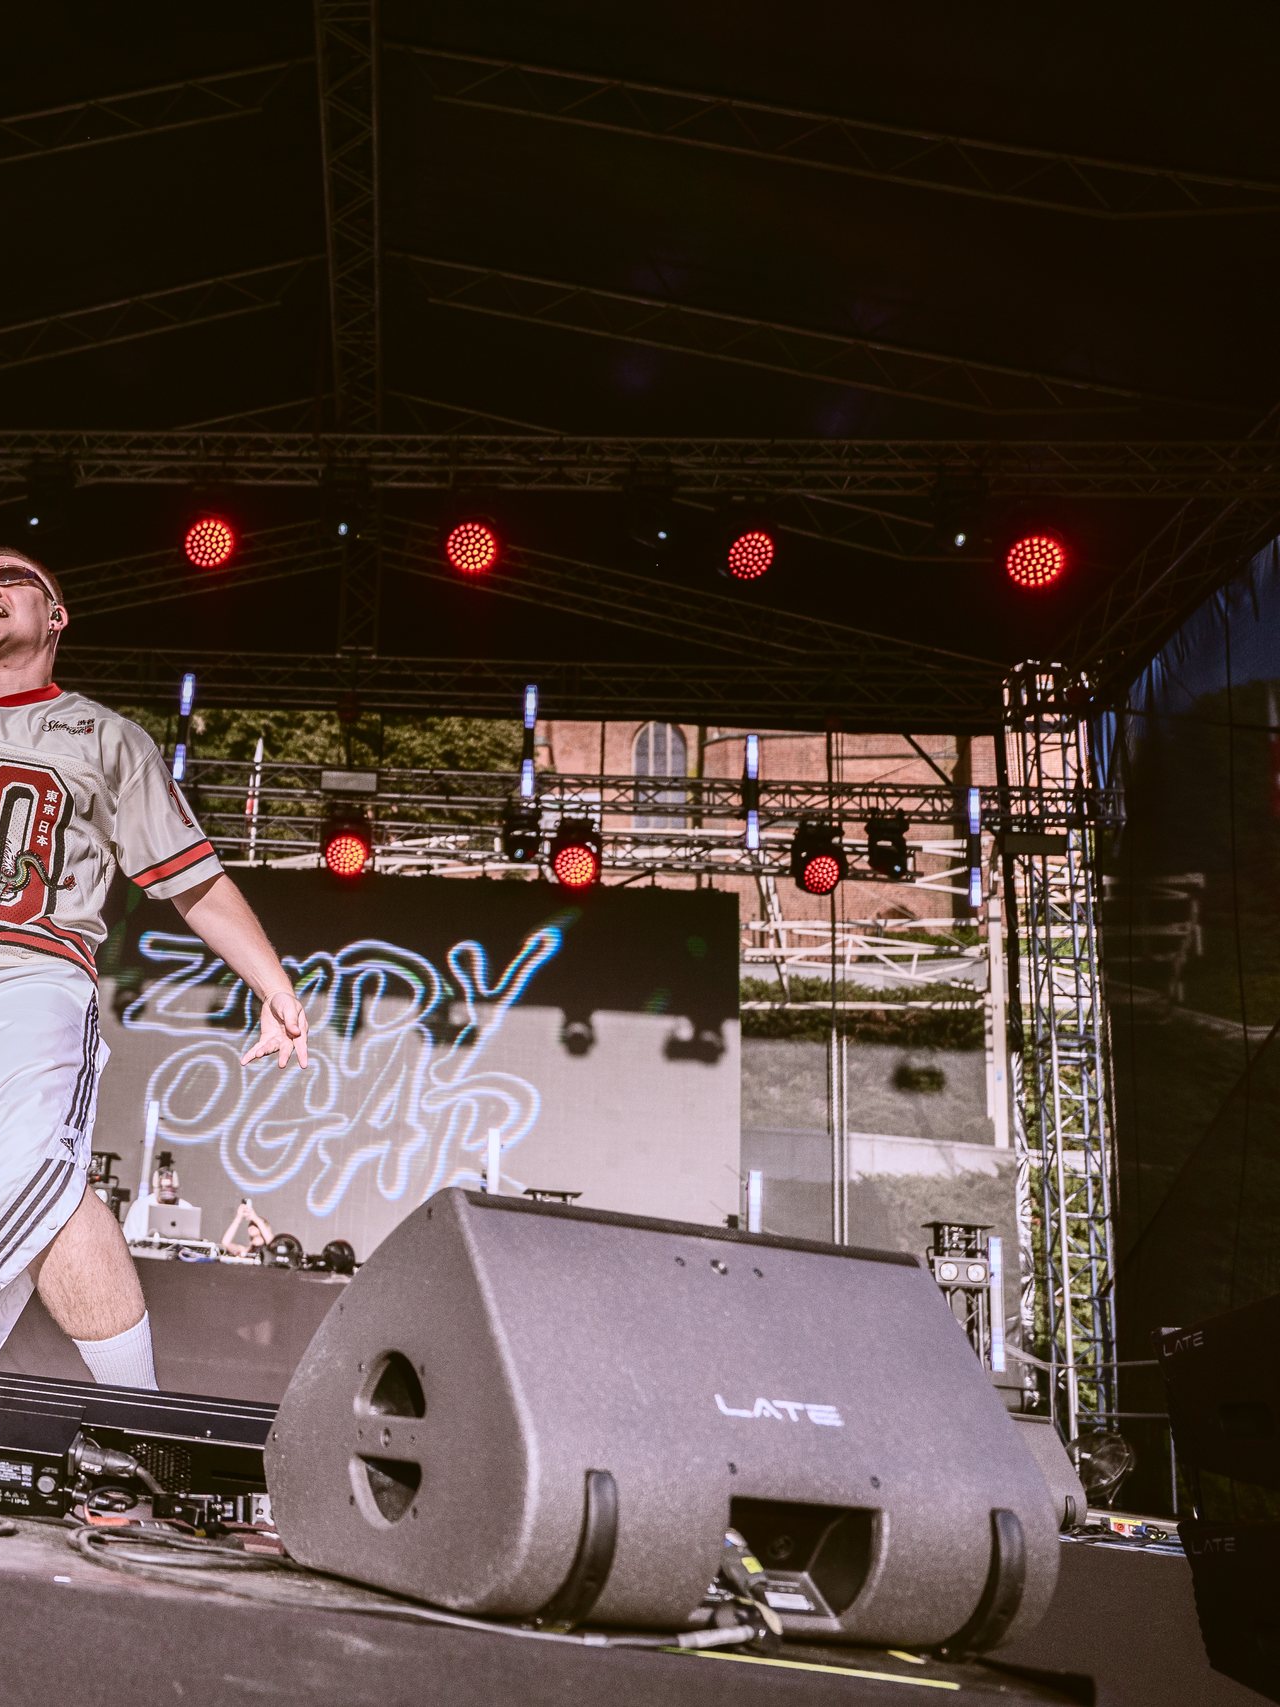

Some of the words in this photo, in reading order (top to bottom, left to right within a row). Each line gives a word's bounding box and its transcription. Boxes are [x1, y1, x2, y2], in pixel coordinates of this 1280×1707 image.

[1162, 1331, 1204, 1357] LATE
[714, 1393, 845, 1427] LATE
[1191, 1537, 1236, 1554] LATE
